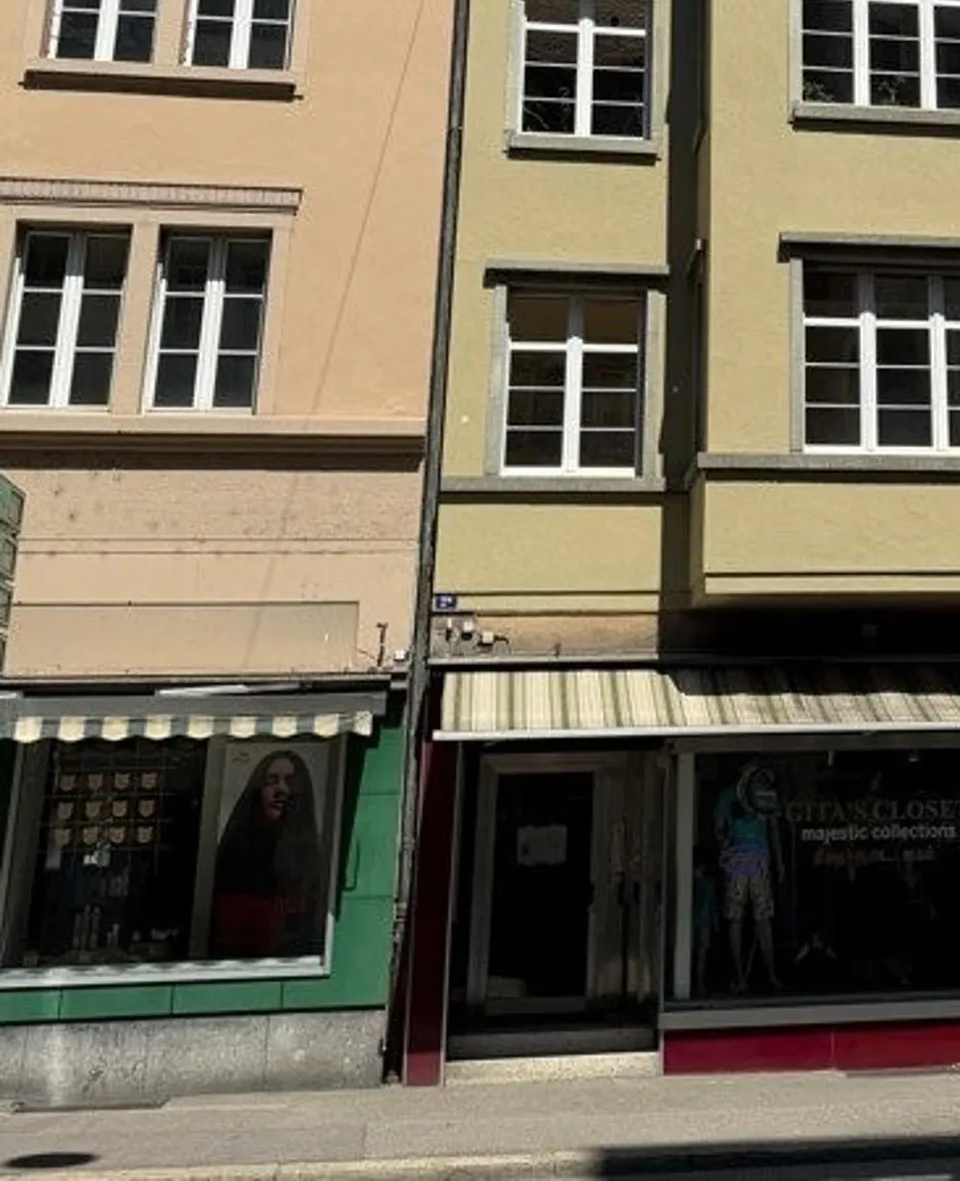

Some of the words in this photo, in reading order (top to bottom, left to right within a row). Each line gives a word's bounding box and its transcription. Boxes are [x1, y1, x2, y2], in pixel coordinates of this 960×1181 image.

[785, 800, 868, 822] GITA'S
[801, 822, 868, 845] majestic
[872, 822, 957, 840] collections
